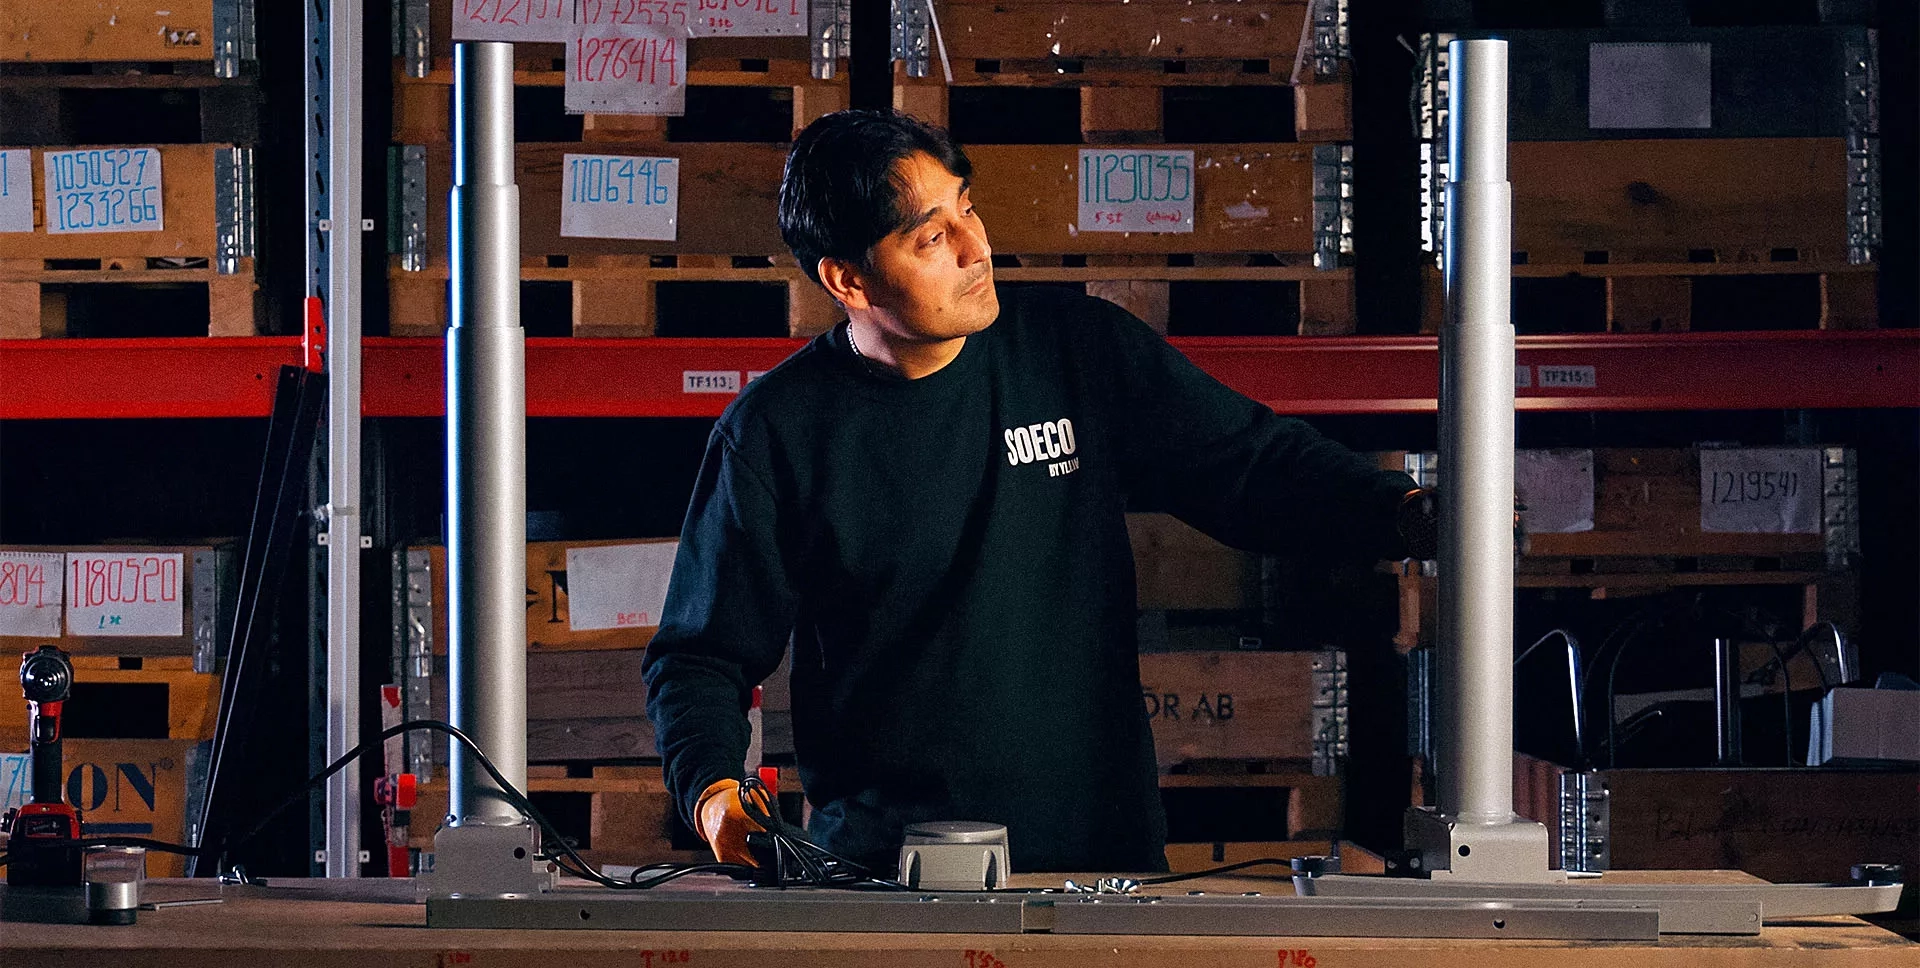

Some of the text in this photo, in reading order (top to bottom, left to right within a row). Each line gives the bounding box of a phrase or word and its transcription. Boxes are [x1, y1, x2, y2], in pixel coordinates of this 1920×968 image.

[577, 37, 677, 87] 1276414
[52, 149, 148, 192] 1050527
[571, 159, 673, 205] 1106446
[1084, 154, 1190, 203] 1129035
[57, 186, 157, 230] 1233266
[1004, 418, 1076, 466] SOECO
[1048, 463, 1060, 477] BY
[1711, 471, 1797, 504] 1219541
[72, 558, 176, 608] 1180520
[1192, 692, 1234, 720] AB
